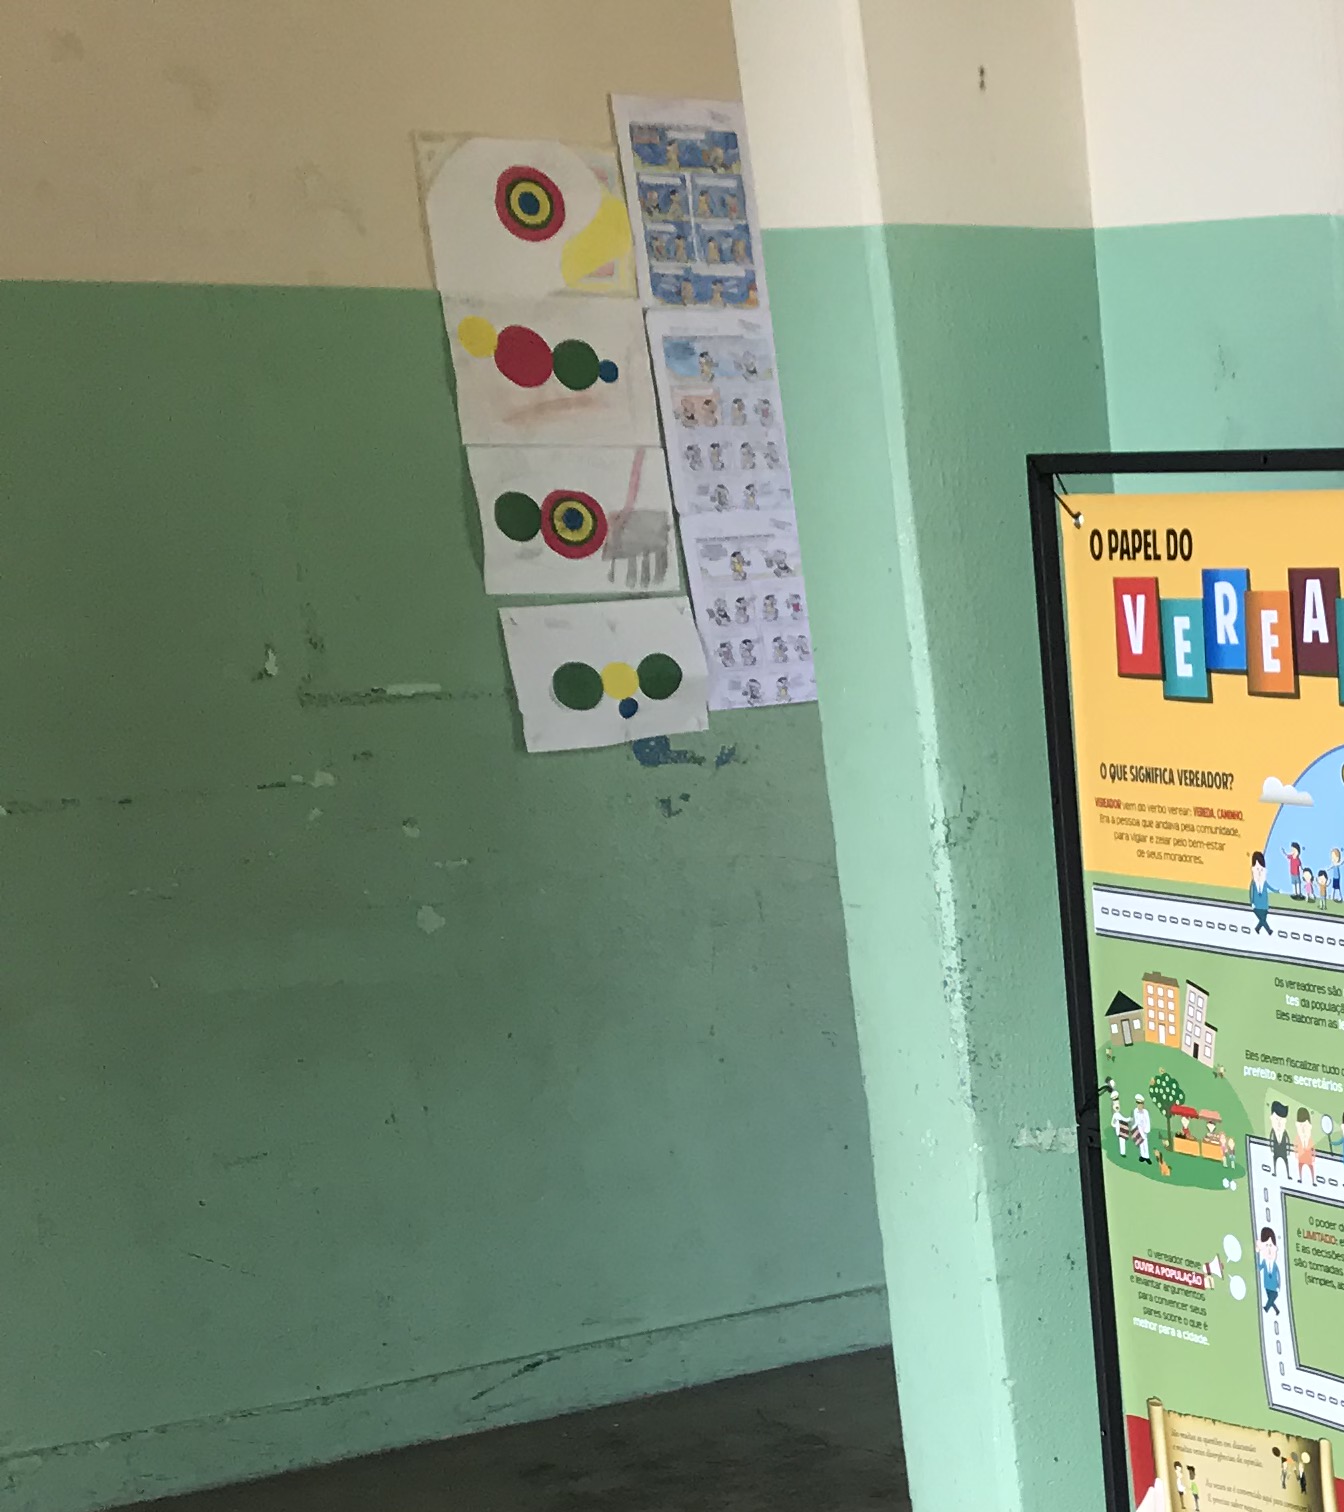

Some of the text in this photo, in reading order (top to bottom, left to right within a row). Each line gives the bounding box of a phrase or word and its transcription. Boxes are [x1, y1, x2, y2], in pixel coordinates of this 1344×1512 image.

[1090, 528, 1193, 561] O PAPEL DO
[1100, 762, 1234, 791] O QUE SIGNIFICA VEREADOR?
